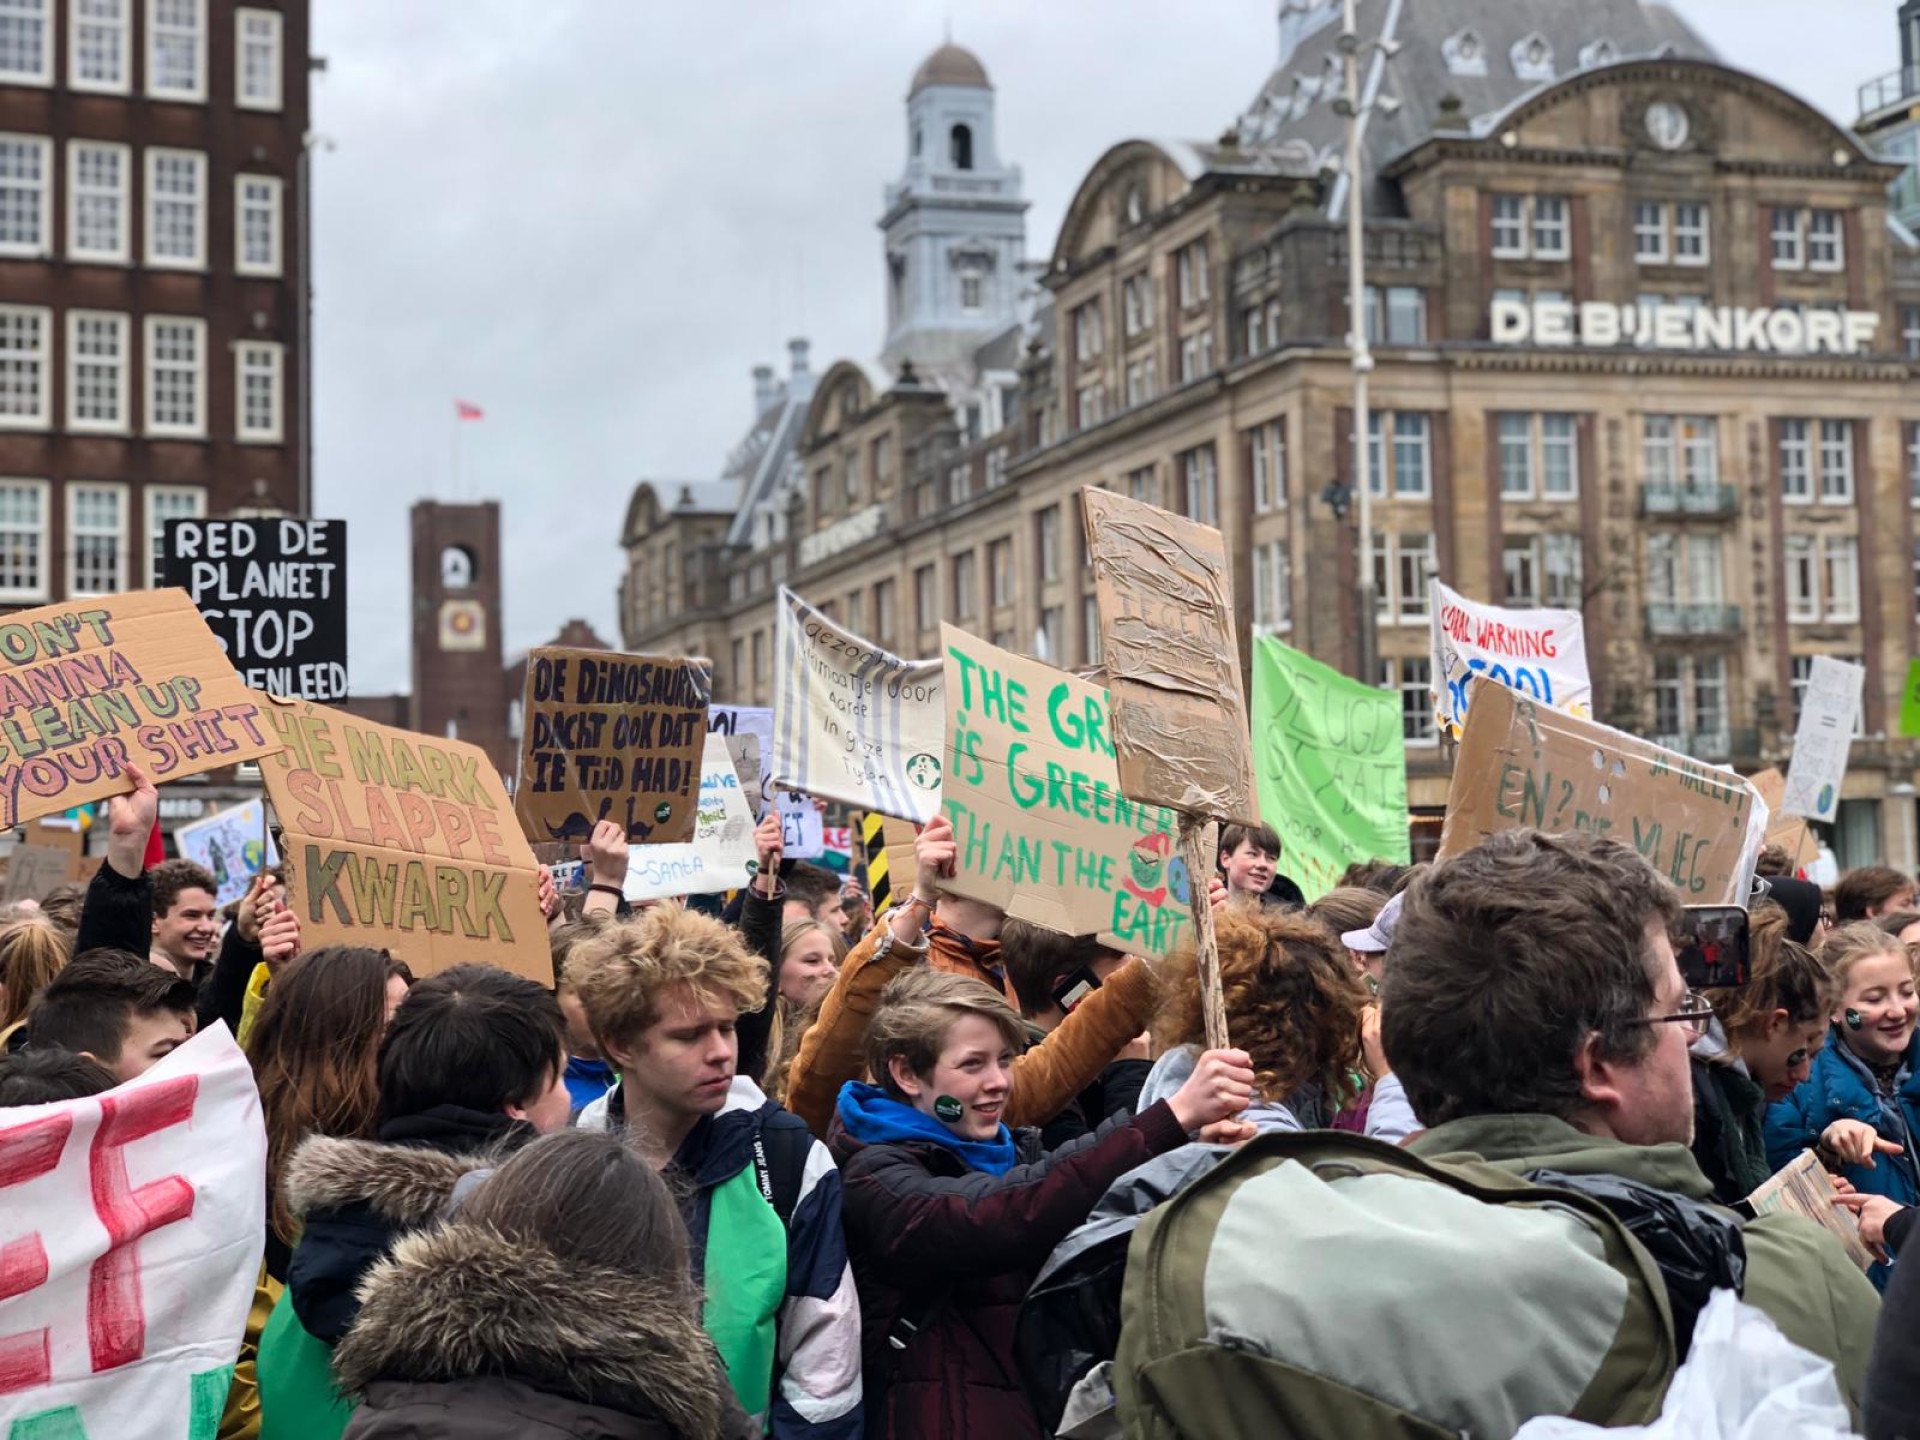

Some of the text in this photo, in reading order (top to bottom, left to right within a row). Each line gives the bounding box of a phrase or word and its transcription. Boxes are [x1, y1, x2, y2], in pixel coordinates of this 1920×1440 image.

[1490, 299, 1880, 355] DE BIJENKORF
[176, 520, 328, 558] RED DE
[191, 561, 336, 604] PLANEET
[1477, 617, 1556, 658] WARMING
[236, 661, 347, 700] ENLEED
[534, 658, 567, 703] DE
[948, 646, 1031, 733] THE
[0, 675, 201, 764] LEAN UP
[612, 711, 657, 750] OOK
[659, 713, 701, 748] DAT
[0, 703, 265, 826] YOUR SHIT
[260, 704, 498, 810] HÉ MARK
[631, 757, 692, 796] HAD!
[287, 768, 511, 866] SLAPPE
[1497, 761, 1573, 829] EN?
[942, 798, 1043, 884] THAN
[1050, 840, 1117, 893] THE
[305, 845, 515, 942] KWARK
[1112, 890, 1190, 955] EART
[754, 1140, 773, 1200] TOMMY JEANS
